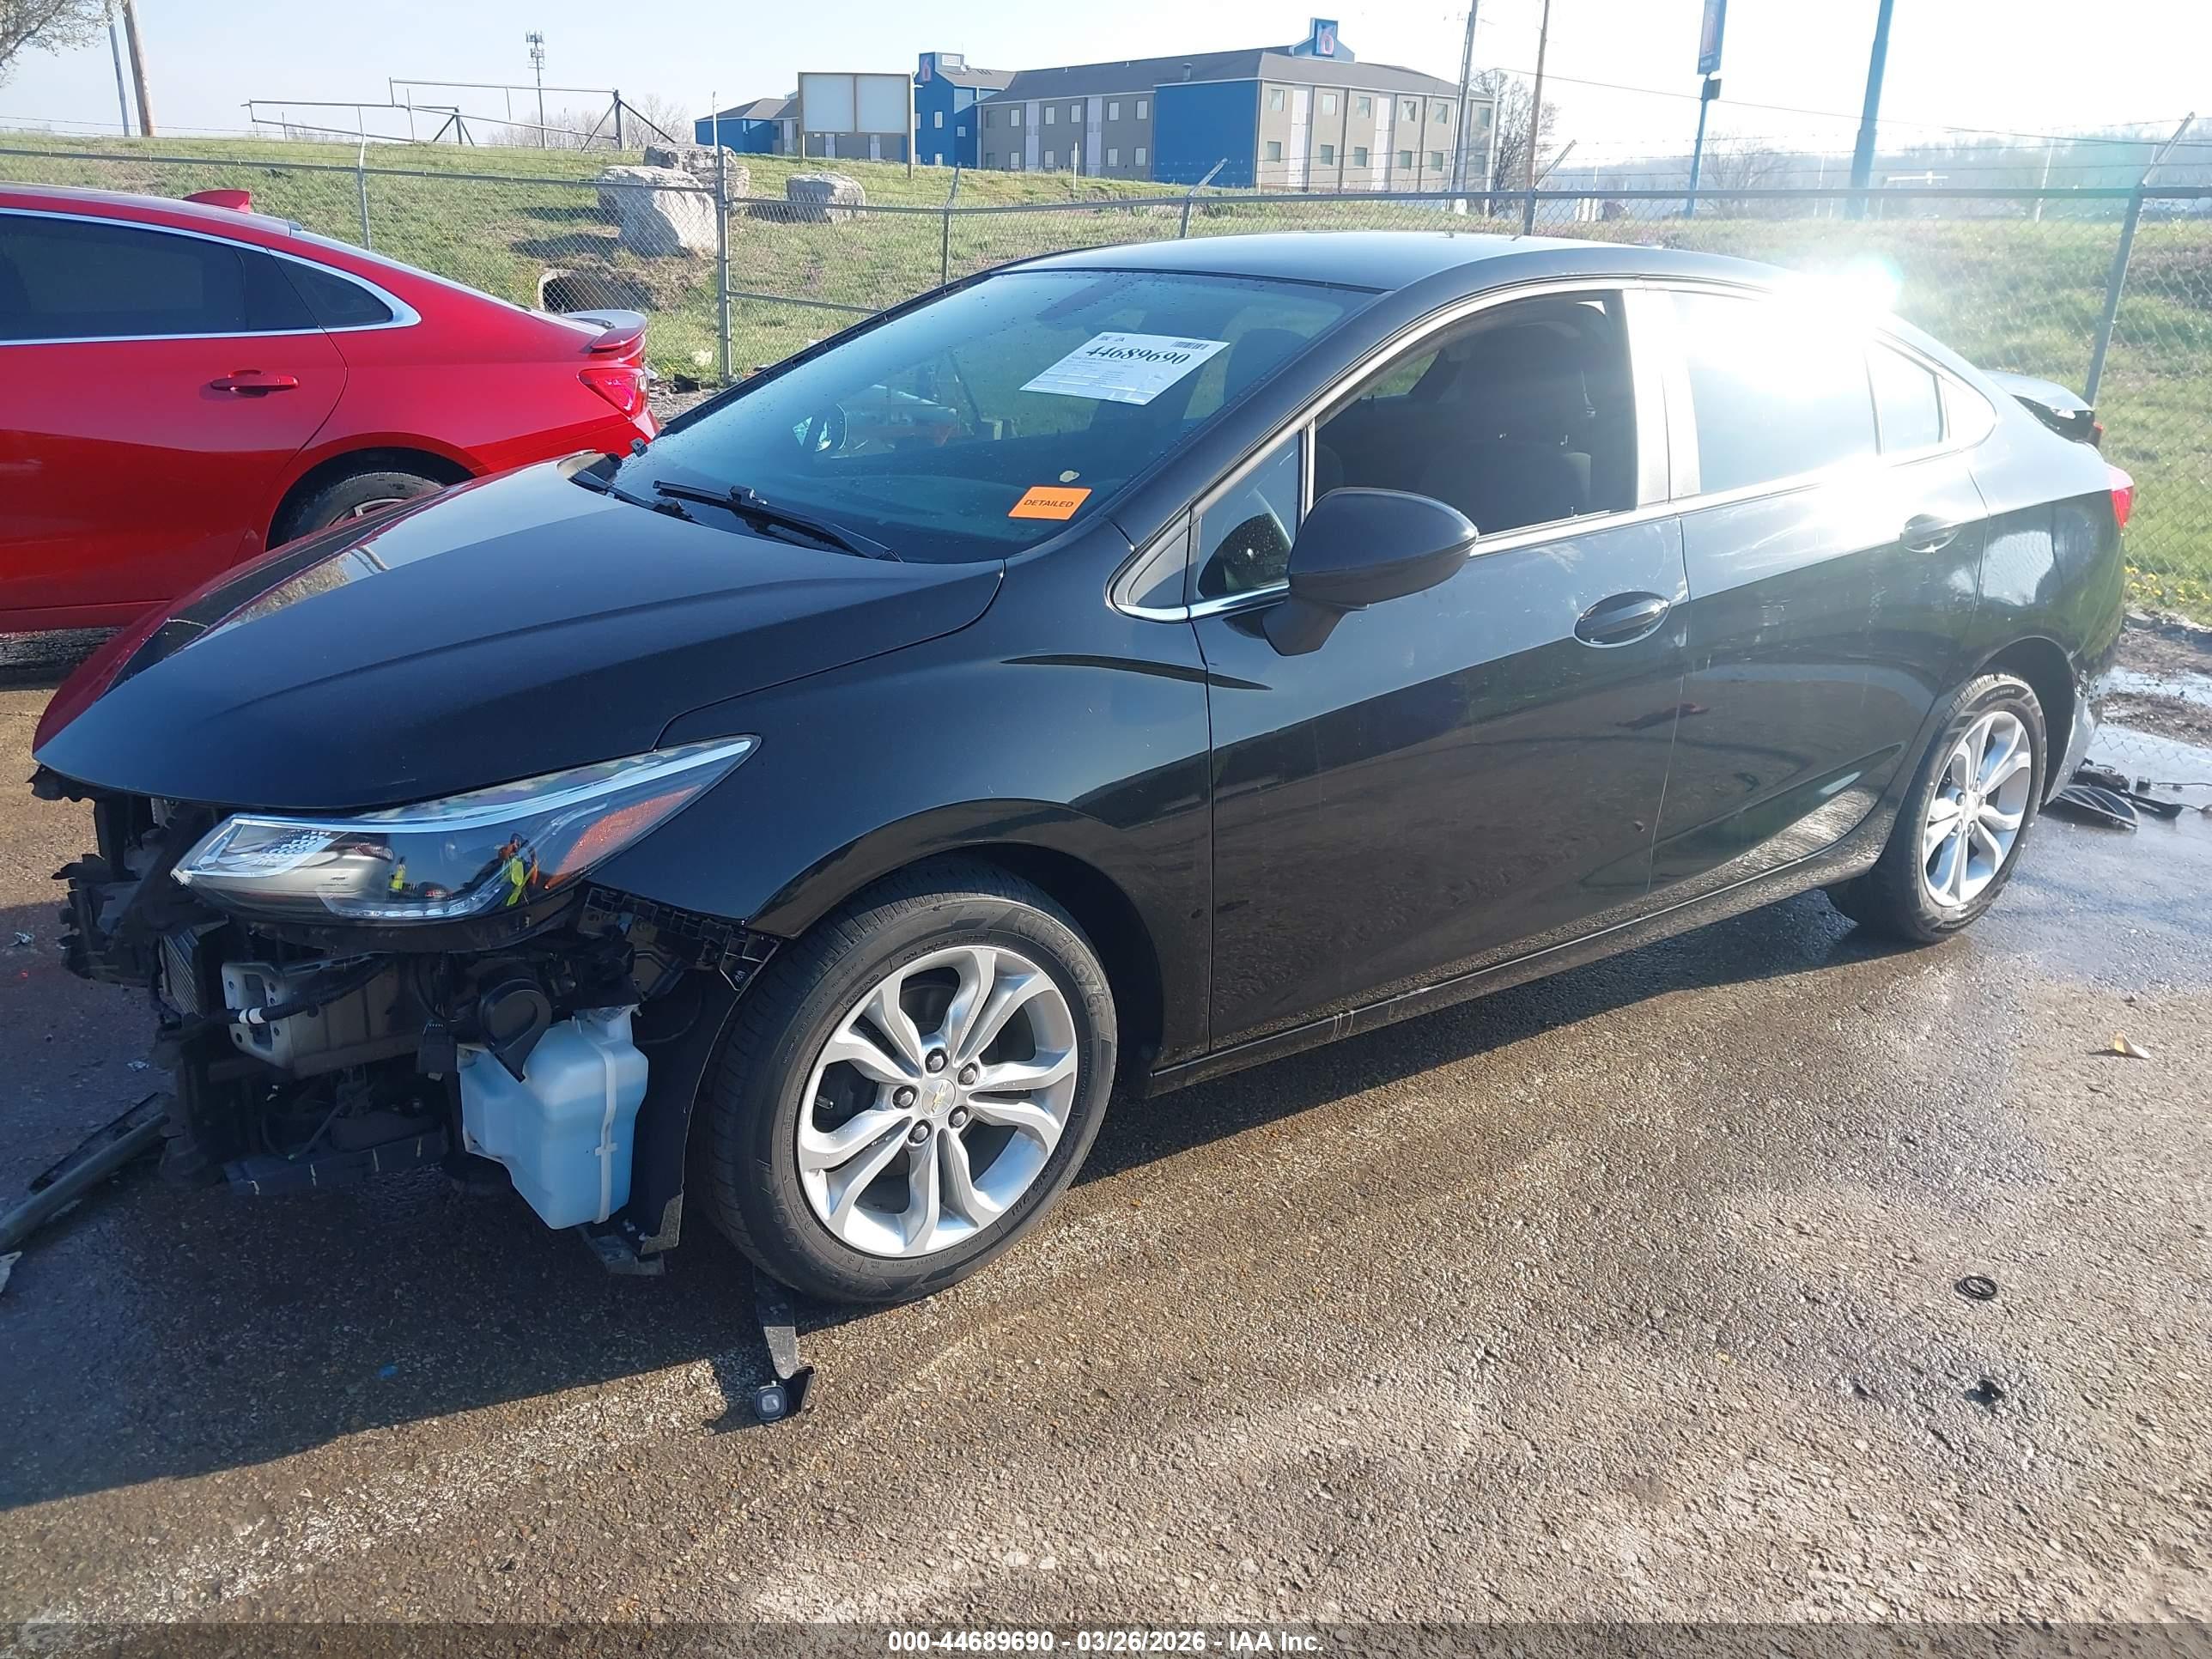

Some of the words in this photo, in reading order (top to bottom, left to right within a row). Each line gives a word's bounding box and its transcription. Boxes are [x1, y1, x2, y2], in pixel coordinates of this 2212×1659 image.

[1320, 24, 1334, 55] 6
[921, 56, 931, 82] 6
[1085, 345, 1191, 365] 44689690
[1024, 500, 1074, 508] DETAILED
